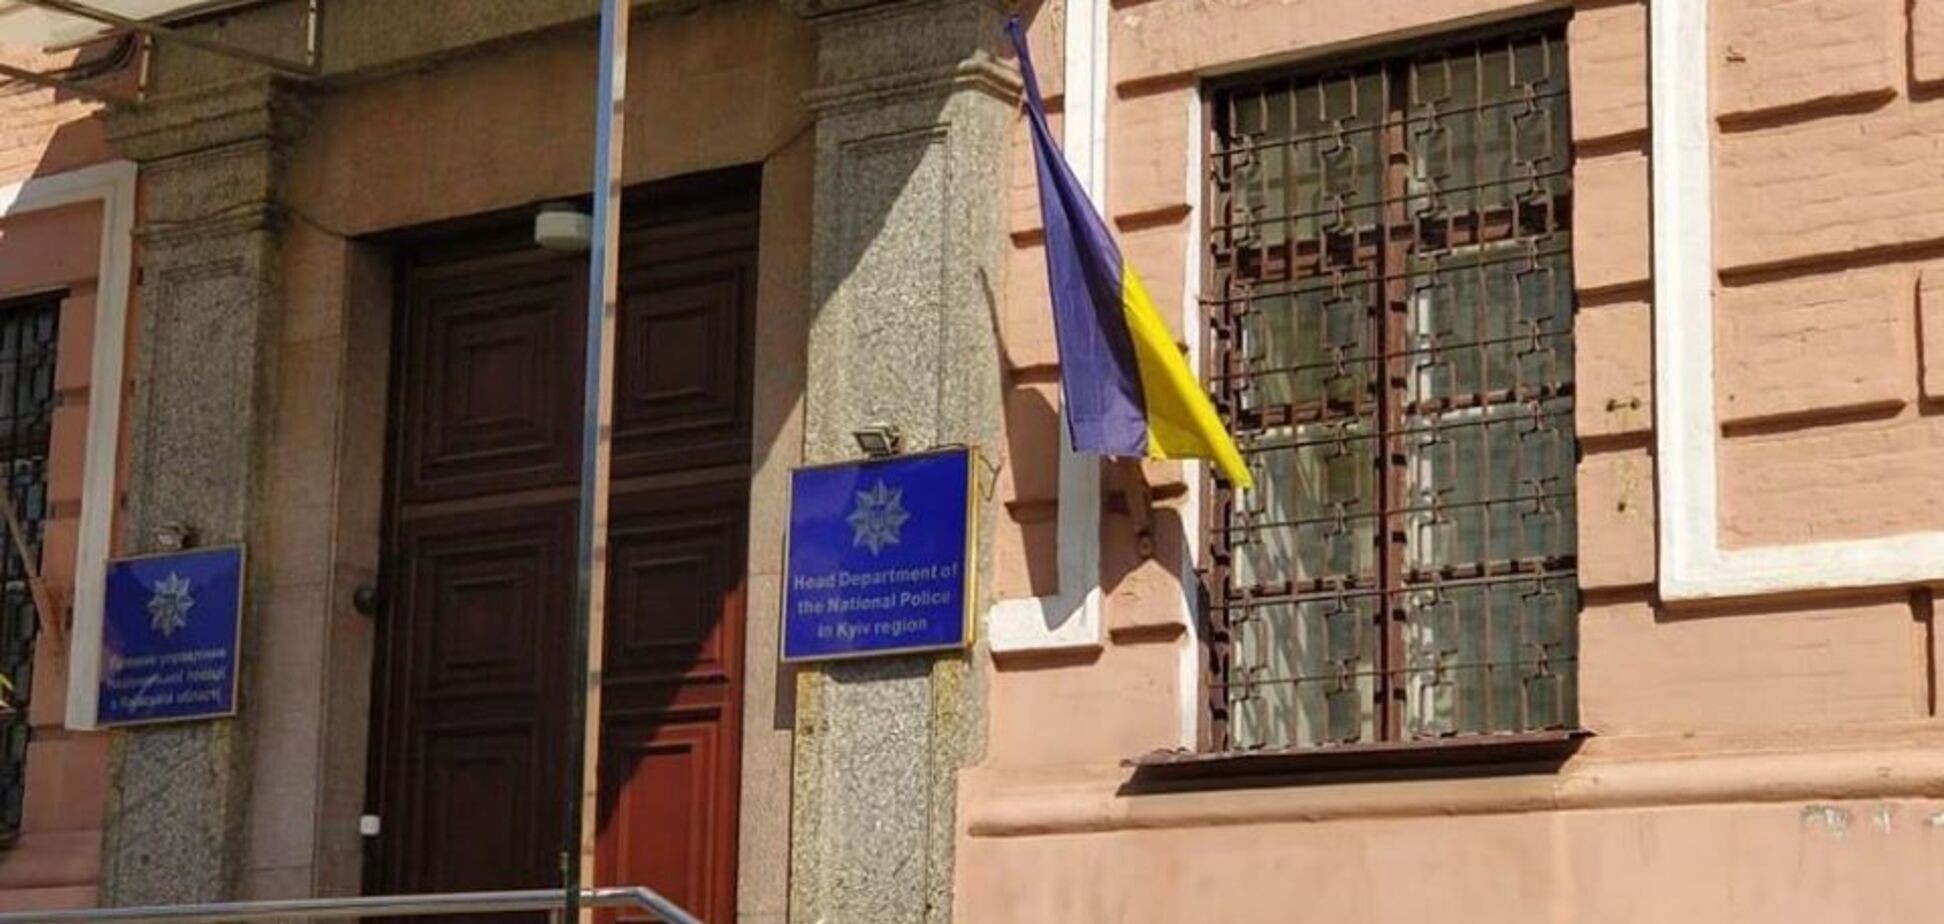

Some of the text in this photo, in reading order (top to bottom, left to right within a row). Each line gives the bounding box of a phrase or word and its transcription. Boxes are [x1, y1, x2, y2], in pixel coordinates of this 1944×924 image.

[794, 563, 958, 590] Head Department of
[797, 590, 950, 615] the National Police
[818, 618, 928, 640] in Kyiv region
